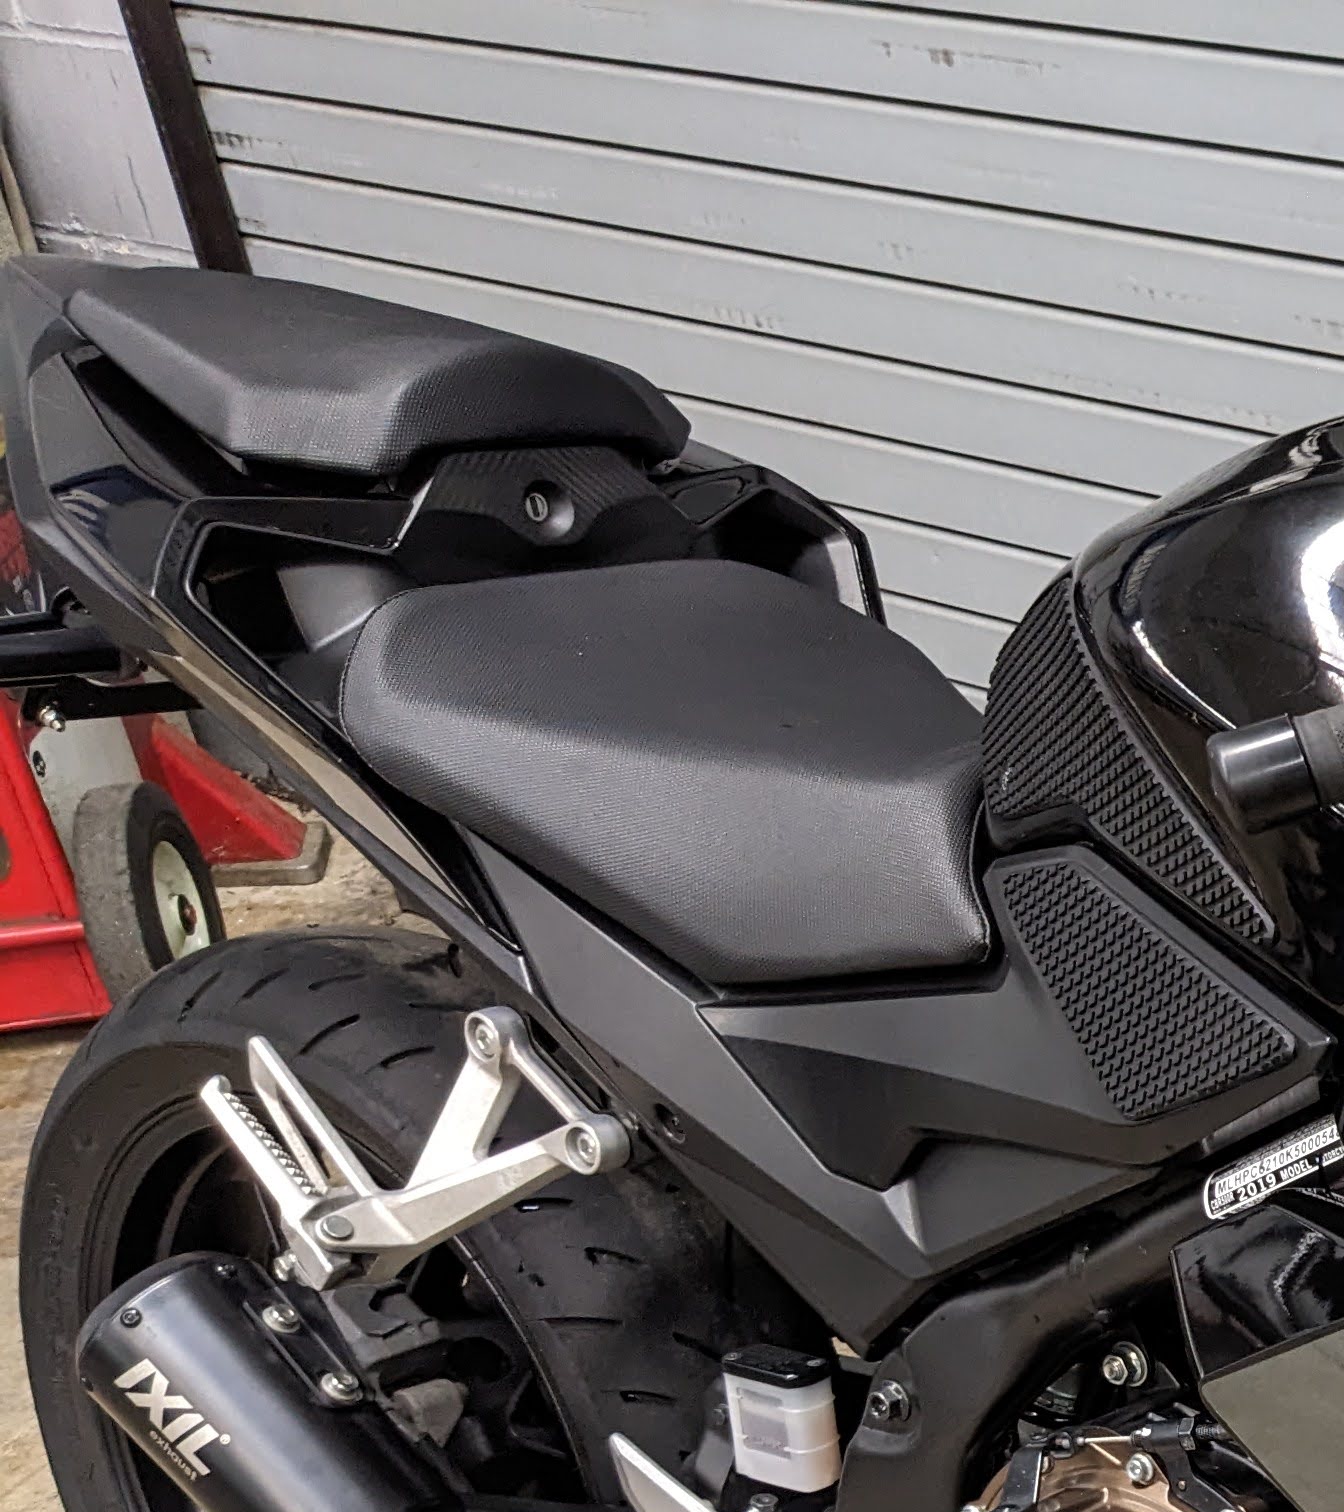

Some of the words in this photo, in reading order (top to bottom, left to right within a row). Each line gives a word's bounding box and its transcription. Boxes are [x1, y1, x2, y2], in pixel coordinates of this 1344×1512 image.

[1237, 1173, 1277, 1201] 2019
[1280, 1159, 1313, 1181] MODEL
[113, 1358, 219, 1476] IXIL
[149, 1430, 197, 1481] exhaust
